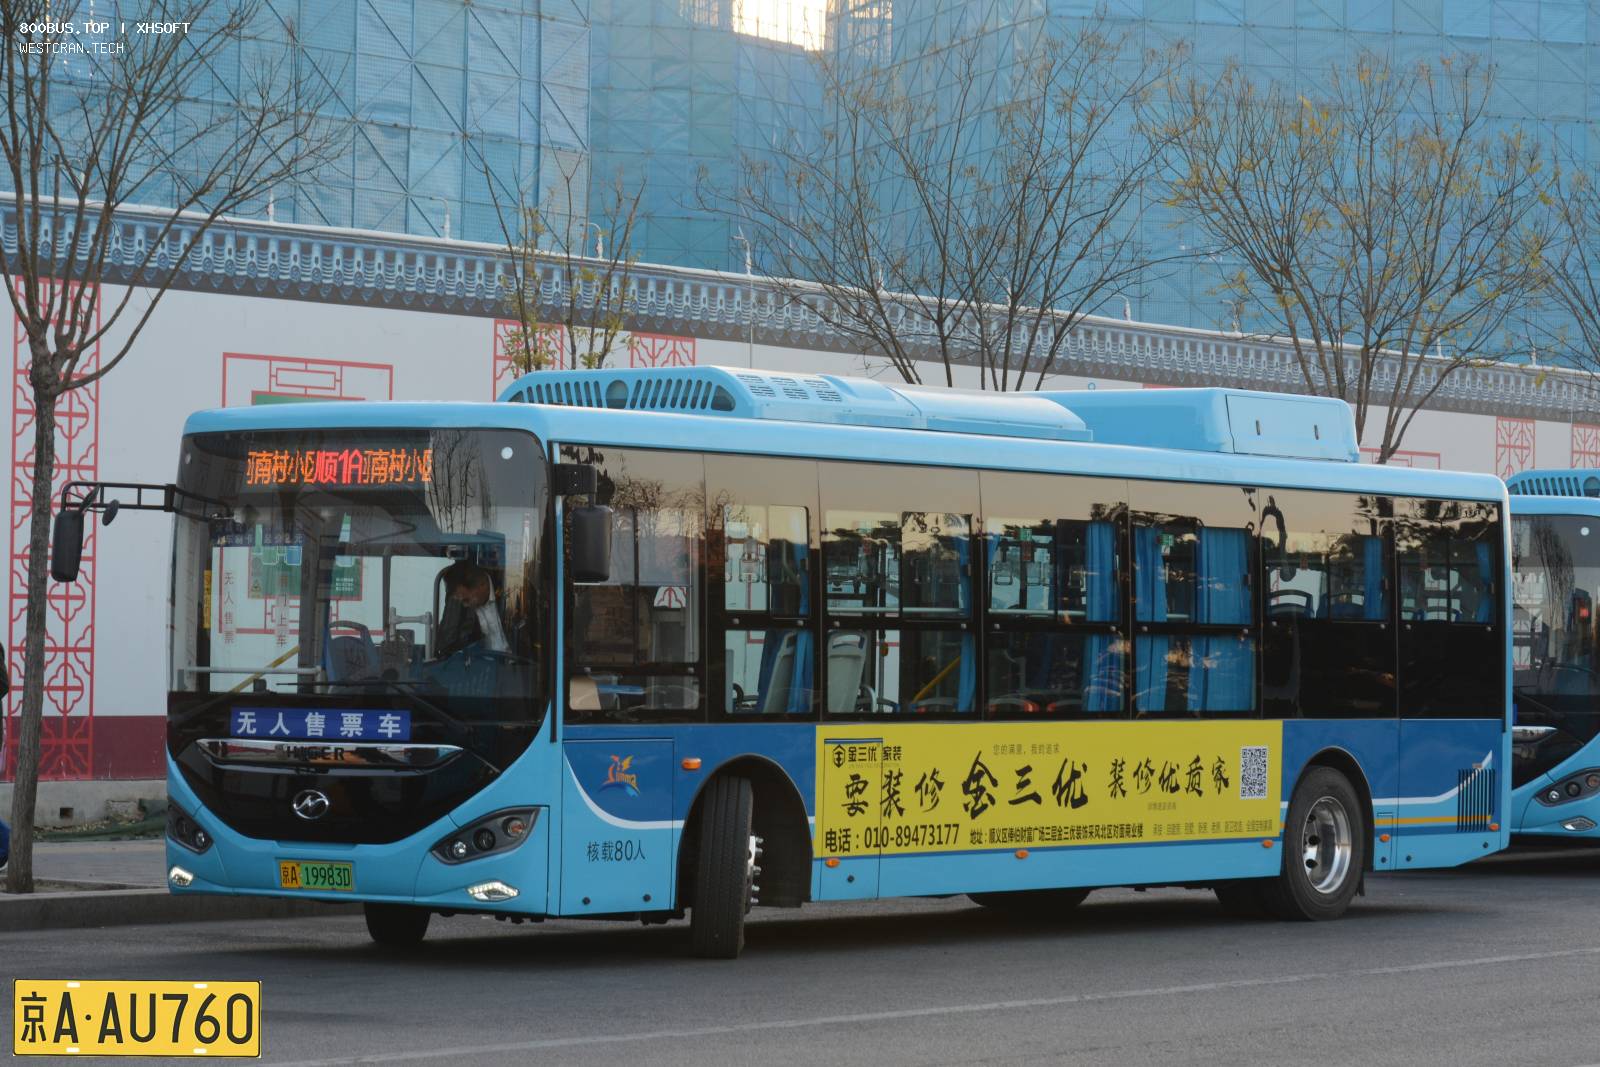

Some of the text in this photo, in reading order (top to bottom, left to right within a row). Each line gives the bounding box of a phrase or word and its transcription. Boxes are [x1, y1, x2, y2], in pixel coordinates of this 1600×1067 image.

[236, 711, 402, 739] 无人售票车
[848, 741, 902, 762] 金三优 家装
[961, 750, 1089, 819] 金三优
[587, 840, 645, 862] 核载80人
